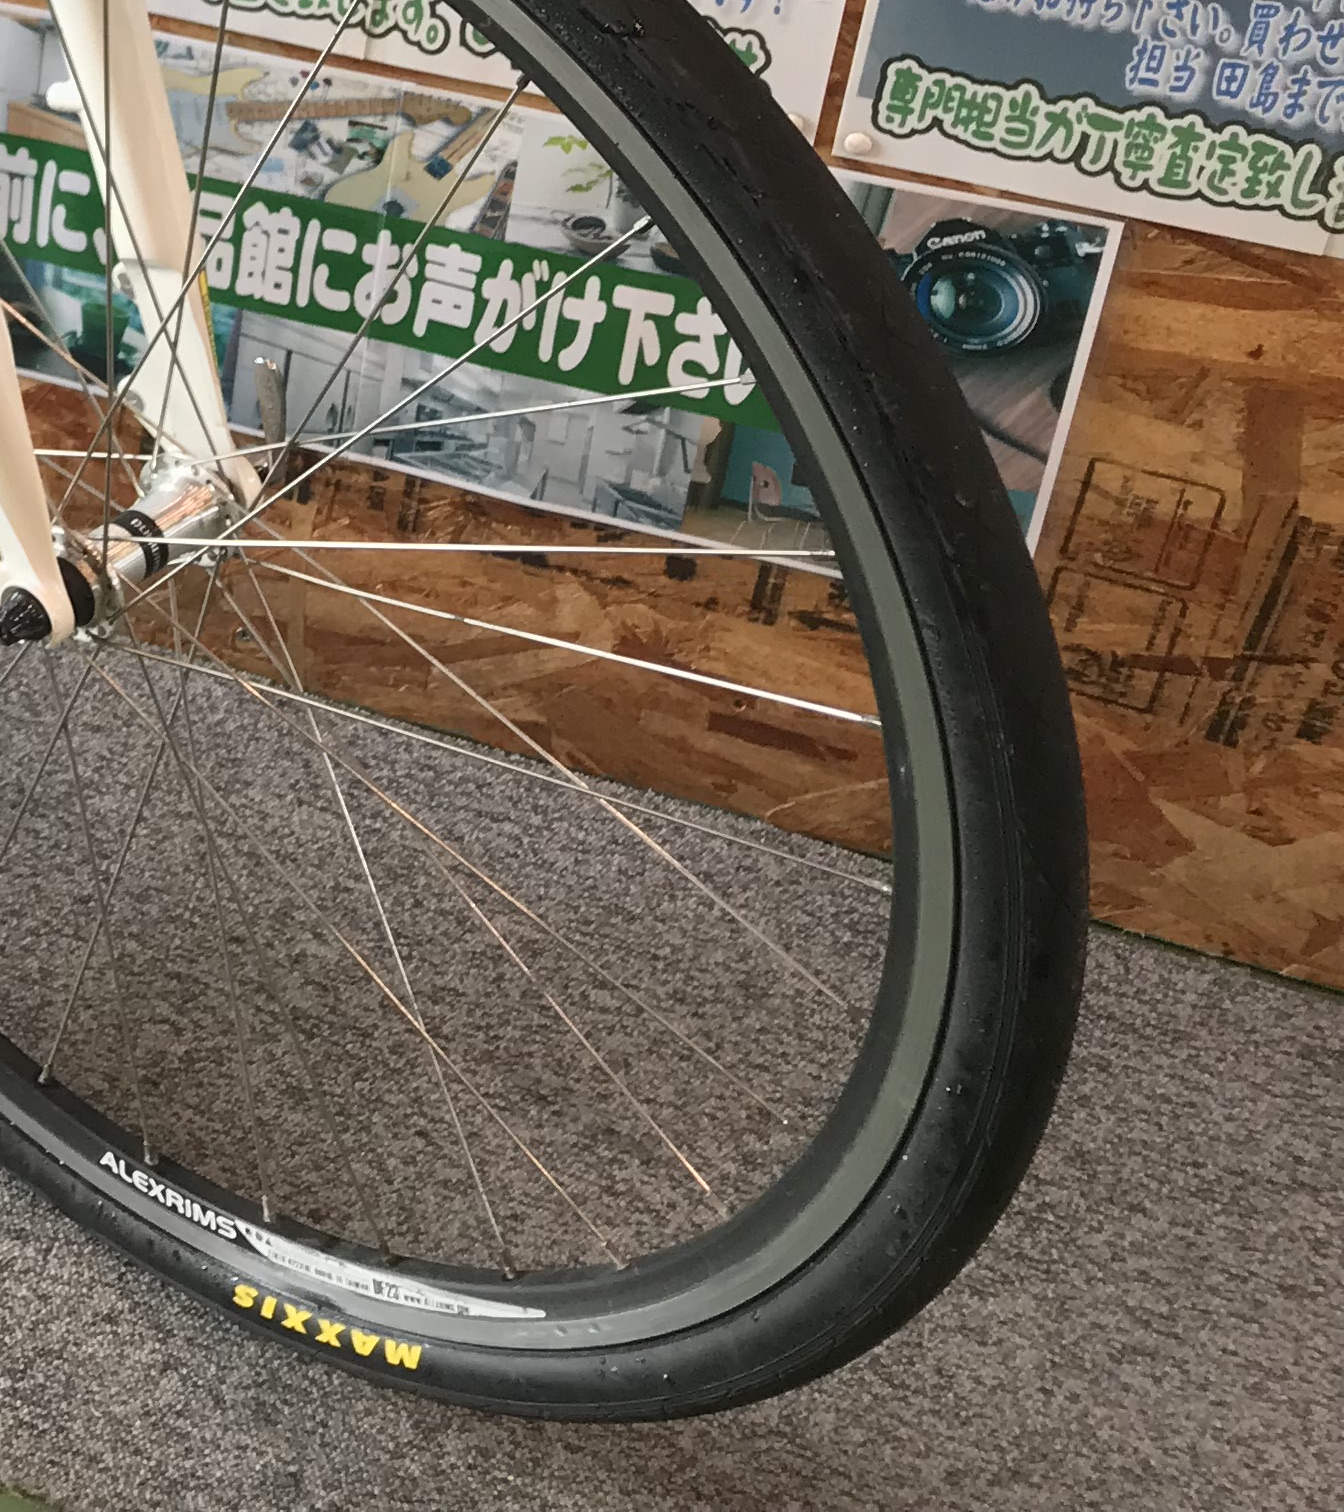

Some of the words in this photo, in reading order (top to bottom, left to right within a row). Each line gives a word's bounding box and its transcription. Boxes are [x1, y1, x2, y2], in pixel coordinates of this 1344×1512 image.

[927, 226, 987, 252] Canon
[98, 1150, 239, 1242] ALEXRIMS
[231, 1283, 424, 1372] MAXXIS
